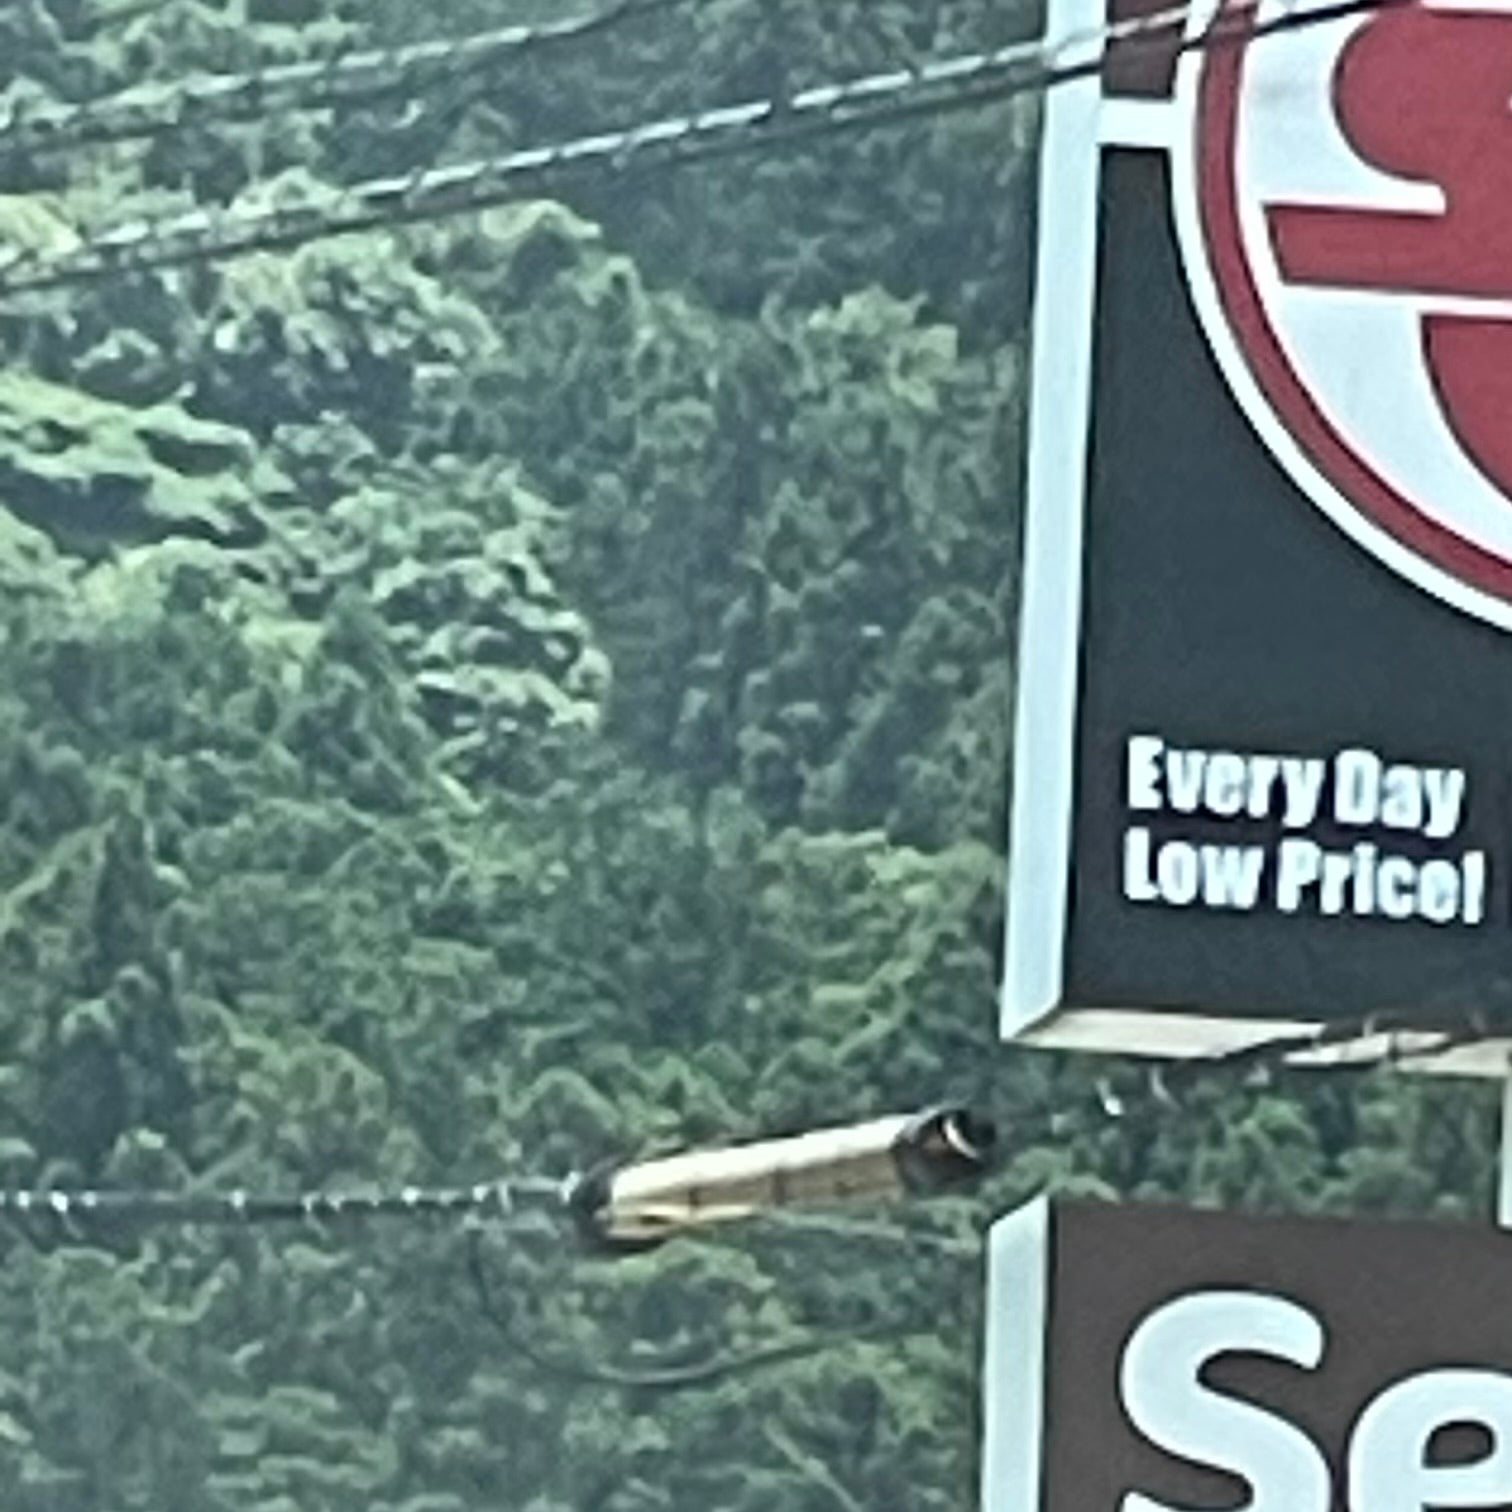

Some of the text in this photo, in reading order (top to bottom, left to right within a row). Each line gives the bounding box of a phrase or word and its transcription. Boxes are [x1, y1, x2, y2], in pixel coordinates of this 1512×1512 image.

[1127, 735, 1466, 838] Every Day
[1124, 826, 1485, 925] Low Price!
